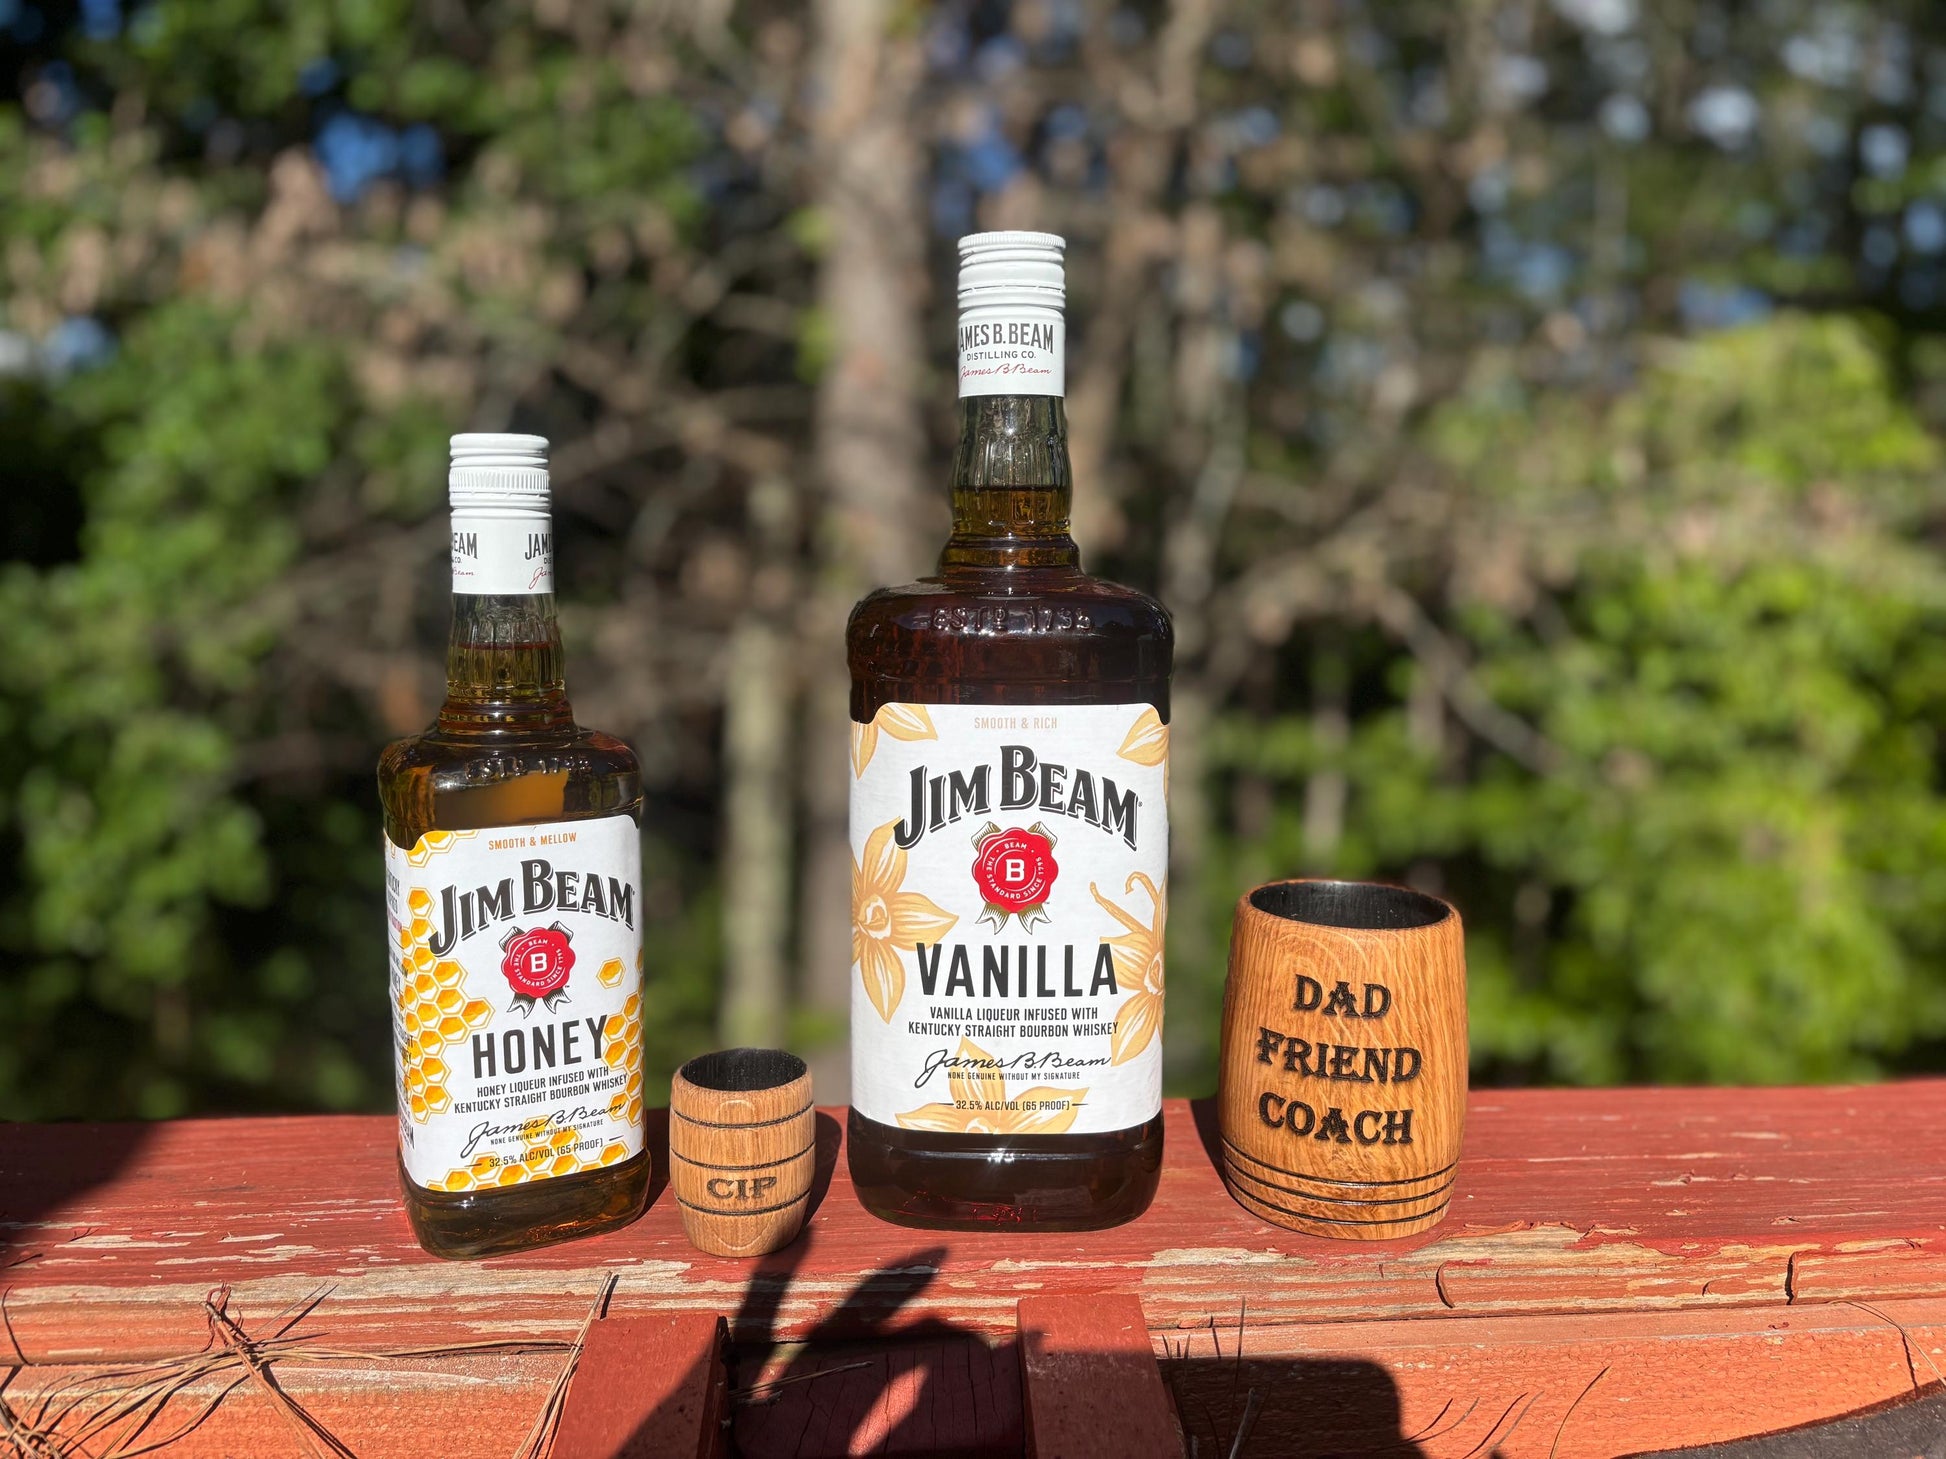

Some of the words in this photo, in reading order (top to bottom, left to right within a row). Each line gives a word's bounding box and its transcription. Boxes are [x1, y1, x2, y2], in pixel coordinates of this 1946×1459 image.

[959, 323, 989, 352] AMES
[1009, 323, 1054, 354] BEAM
[966, 351, 1018, 361] DISTILLING
[1021, 350, 1037, 359] CO.
[452, 532, 478, 559] EAM
[974, 717, 1017, 729] SMOOTH
[1021, 717, 1029, 729] &
[1033, 717, 1058, 729] RICH
[893, 764, 992, 850] JIM
[1000, 745, 1138, 852] BEAM
[489, 837, 526, 850] SMOOTH
[530, 837, 537, 846] &
[540, 832, 578, 845] MELLOW
[1004, 842, 1027, 850] BEAM
[1005, 859, 1025, 882] B
[986, 873, 1021, 899] STANDARD
[428, 878, 515, 957] JIM
[520, 859, 635, 932] BEAM
[530, 952, 548, 973] B
[915, 942, 1119, 998] VANILLA
[1293, 973, 1392, 1018] DAD
[930, 1006, 973, 1021] VANILLA
[977, 1008, 1020, 1022] LIQUEUR
[1024, 1007, 1067, 1021] INFUSED
[1071, 1006, 1098, 1020] WITH
[908, 1021, 961, 1037] KENTUCKY
[965, 1023, 1016, 1038] STRAIGHT
[1020, 1025, 1069, 1038] BOURBON
[1073, 1021, 1119, 1036] WHISKEY
[472, 1015, 607, 1079] HONEY
[1257, 1026, 1422, 1083] FRIEND
[477, 1082, 507, 1098] HONEY
[509, 1078, 546, 1094] LIQUEUR
[549, 1071, 585, 1088] INFUSED
[587, 1066, 609, 1080] WITH
[914, 1048, 1009, 1089] James
[1039, 1051, 1112, 1069] Beam
[948, 1071, 965, 1080] NONE
[967, 1072, 996, 1080] GENUINE
[999, 1072, 1029, 1081] WITHOUT
[1031, 1072, 1041, 1080] MY
[1044, 1071, 1080, 1080] SIGNATURE
[454, 1099, 501, 1114] KENTUCKY
[504, 1093, 547, 1109] STRAIGHT
[550, 1084, 590, 1101] BOURBON
[593, 1074, 628, 1092] WHISKEY
[956, 1100, 982, 1111] 32.5%
[985, 1101, 1020, 1111] ALC/VOL
[1022, 1100, 1037, 1111] (65
[1039, 1100, 1070, 1111] PROOF)
[460, 1118, 544, 1159] James
[567, 1102, 626, 1120] Beam
[490, 1137, 506, 1145] NONE
[508, 1133, 533, 1143] GENUINE
[535, 1128, 561, 1139] WITHOUT
[573, 1119, 604, 1130] SIGNATURE
[1258, 1091, 1414, 1146] COACH
[489, 1155, 518, 1168] 32.5%
[519, 1148, 554, 1164] ALC/VOL
[557, 1144, 571, 1157] (65
[573, 1137, 604, 1152] PROOF)
[706, 1176, 778, 1200] CIP
